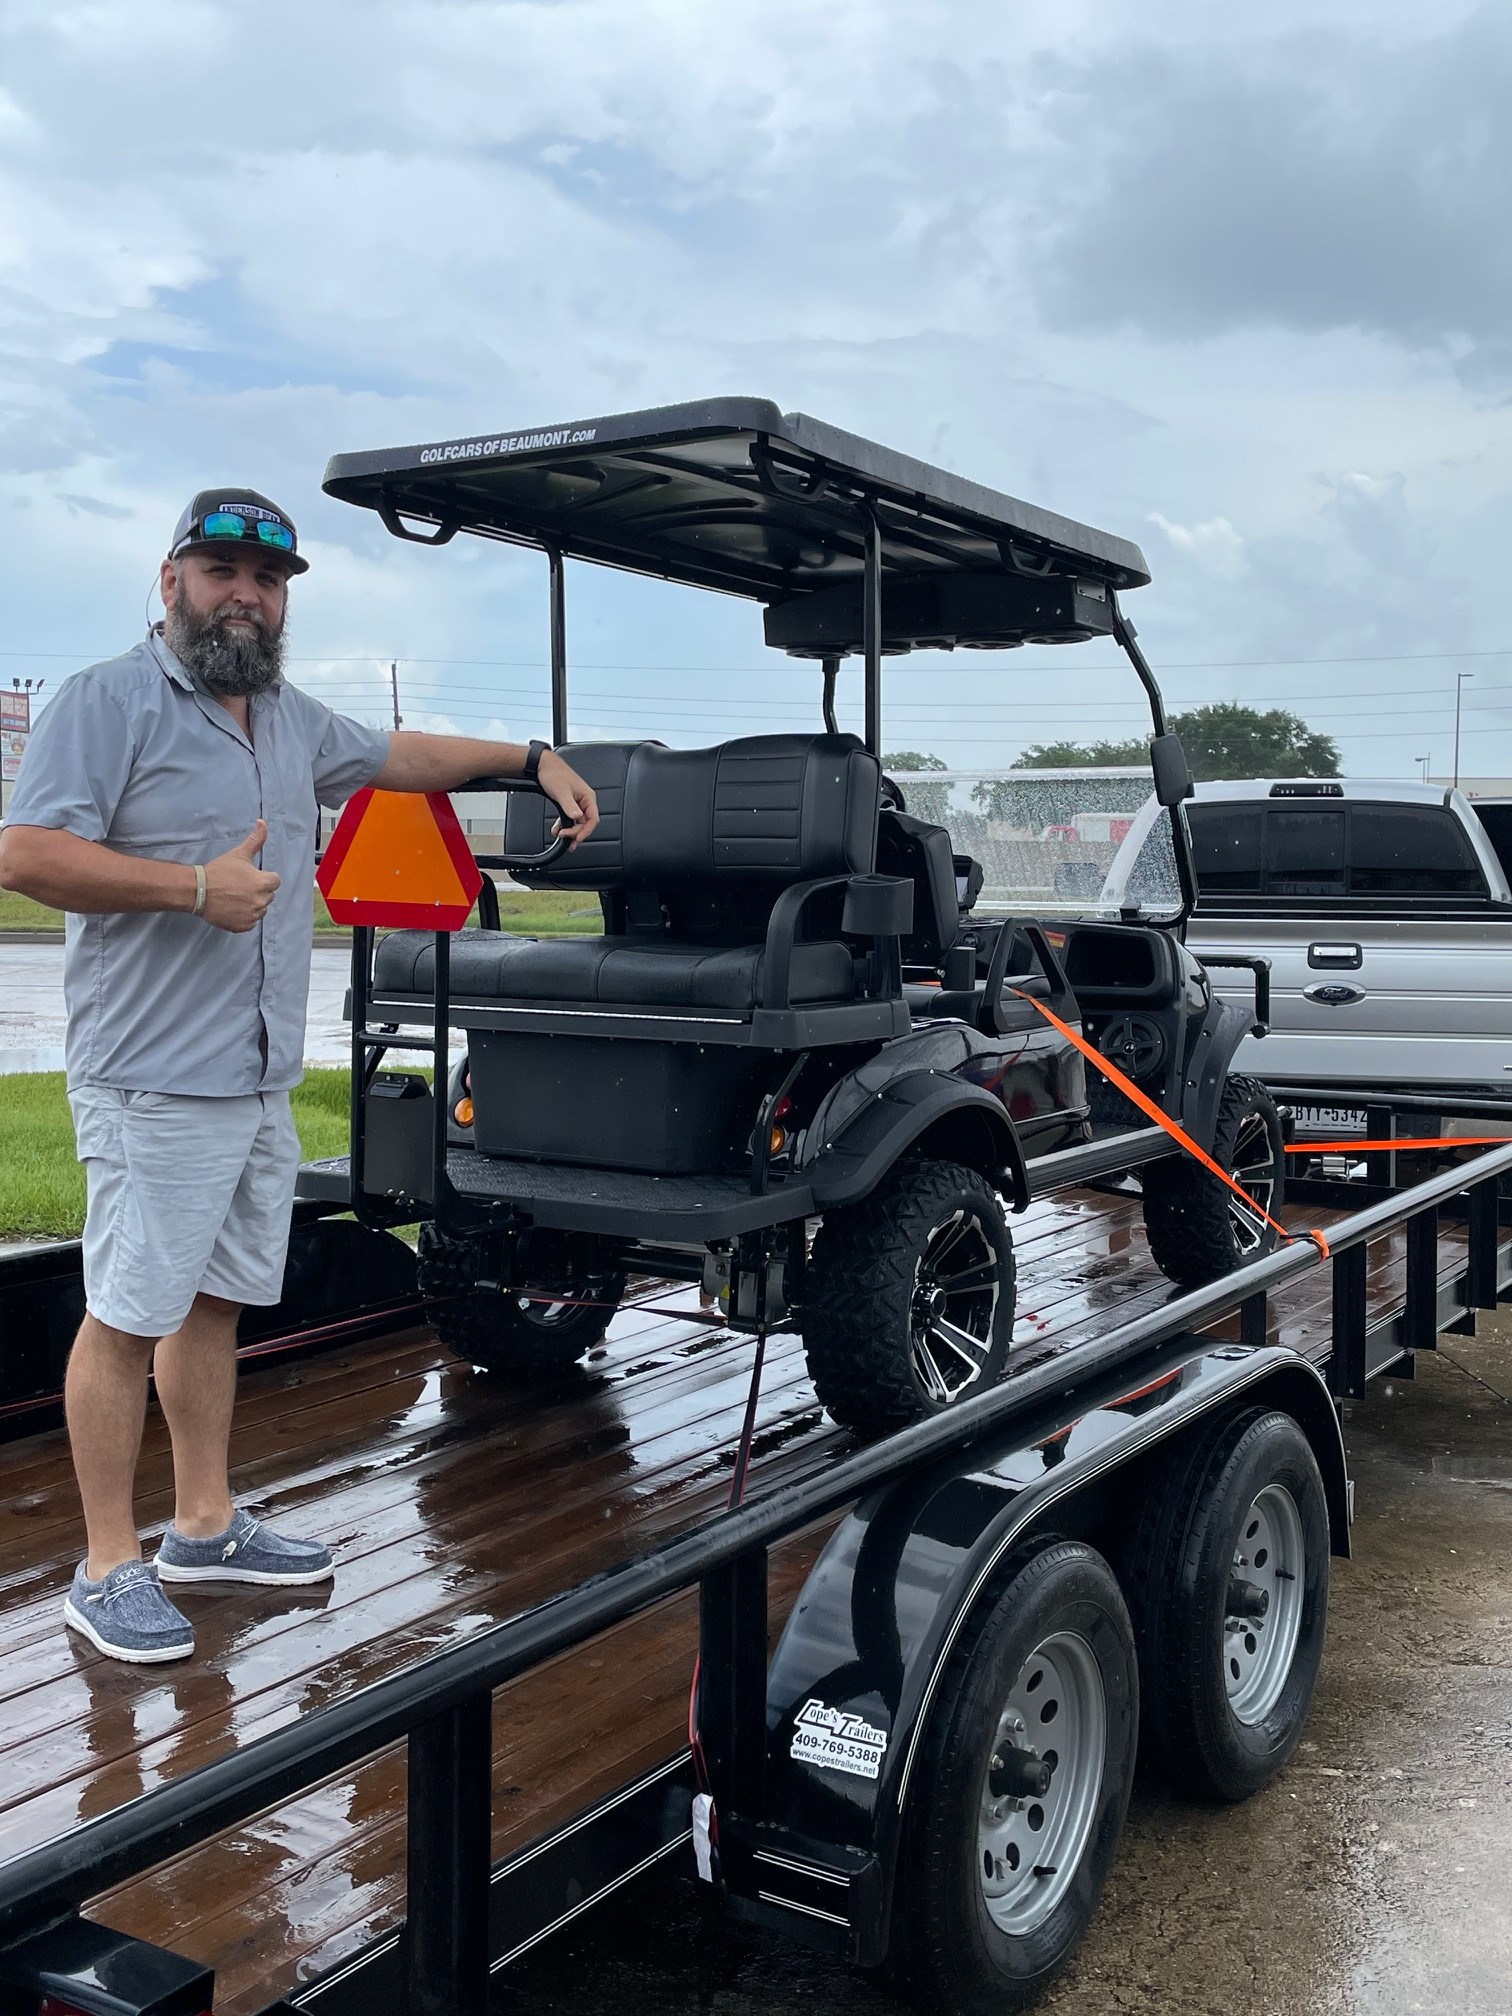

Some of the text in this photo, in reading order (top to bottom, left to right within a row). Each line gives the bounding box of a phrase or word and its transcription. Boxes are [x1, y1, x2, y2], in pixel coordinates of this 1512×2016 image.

[1322, 987, 1349, 999] Ford
[839, 1716, 884, 1742] Trailers
[795, 1733, 878, 1763] 409-769-5388
